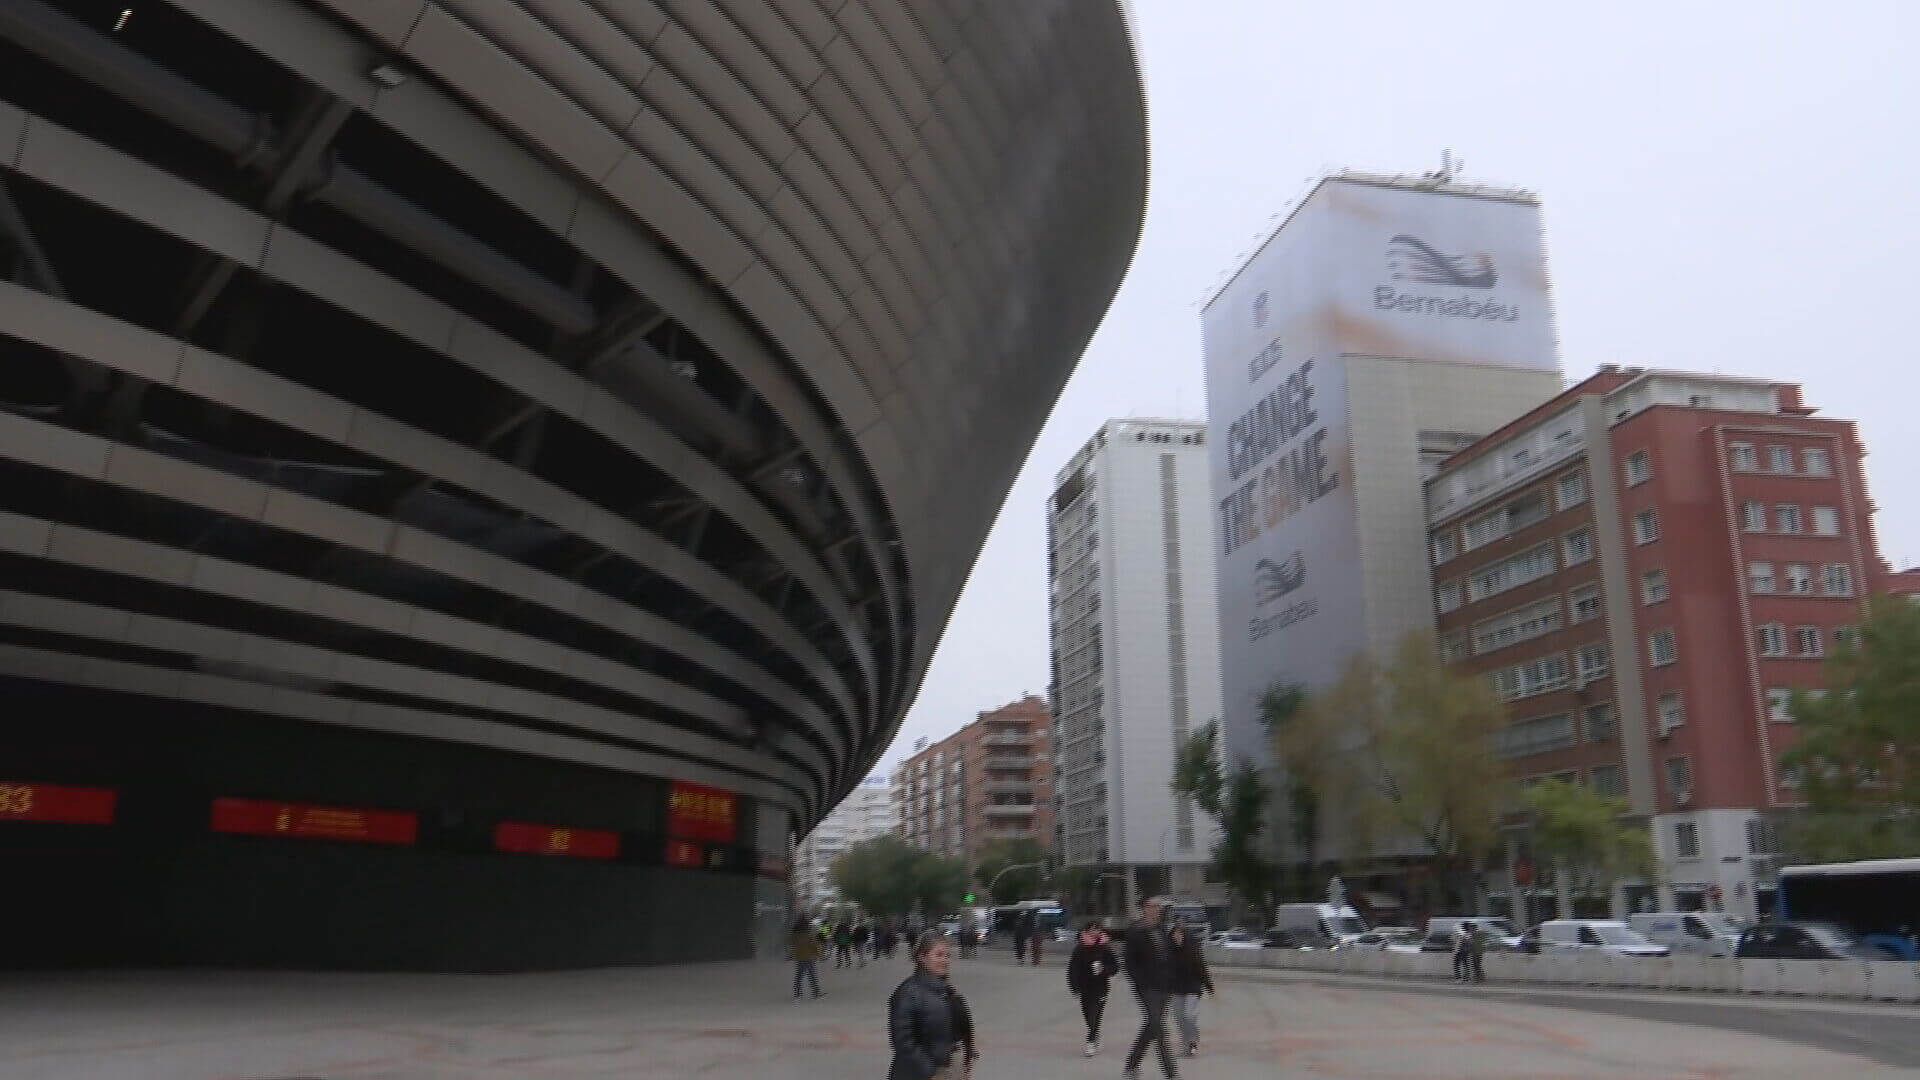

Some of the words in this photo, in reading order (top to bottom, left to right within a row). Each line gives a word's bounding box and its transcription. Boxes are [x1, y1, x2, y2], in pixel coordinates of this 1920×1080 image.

[1373, 284, 1519, 323] Bernabéu
[1226, 359, 1319, 482] CHANGE
[1219, 479, 1261, 559] THE
[1262, 426, 1340, 530] GAME.
